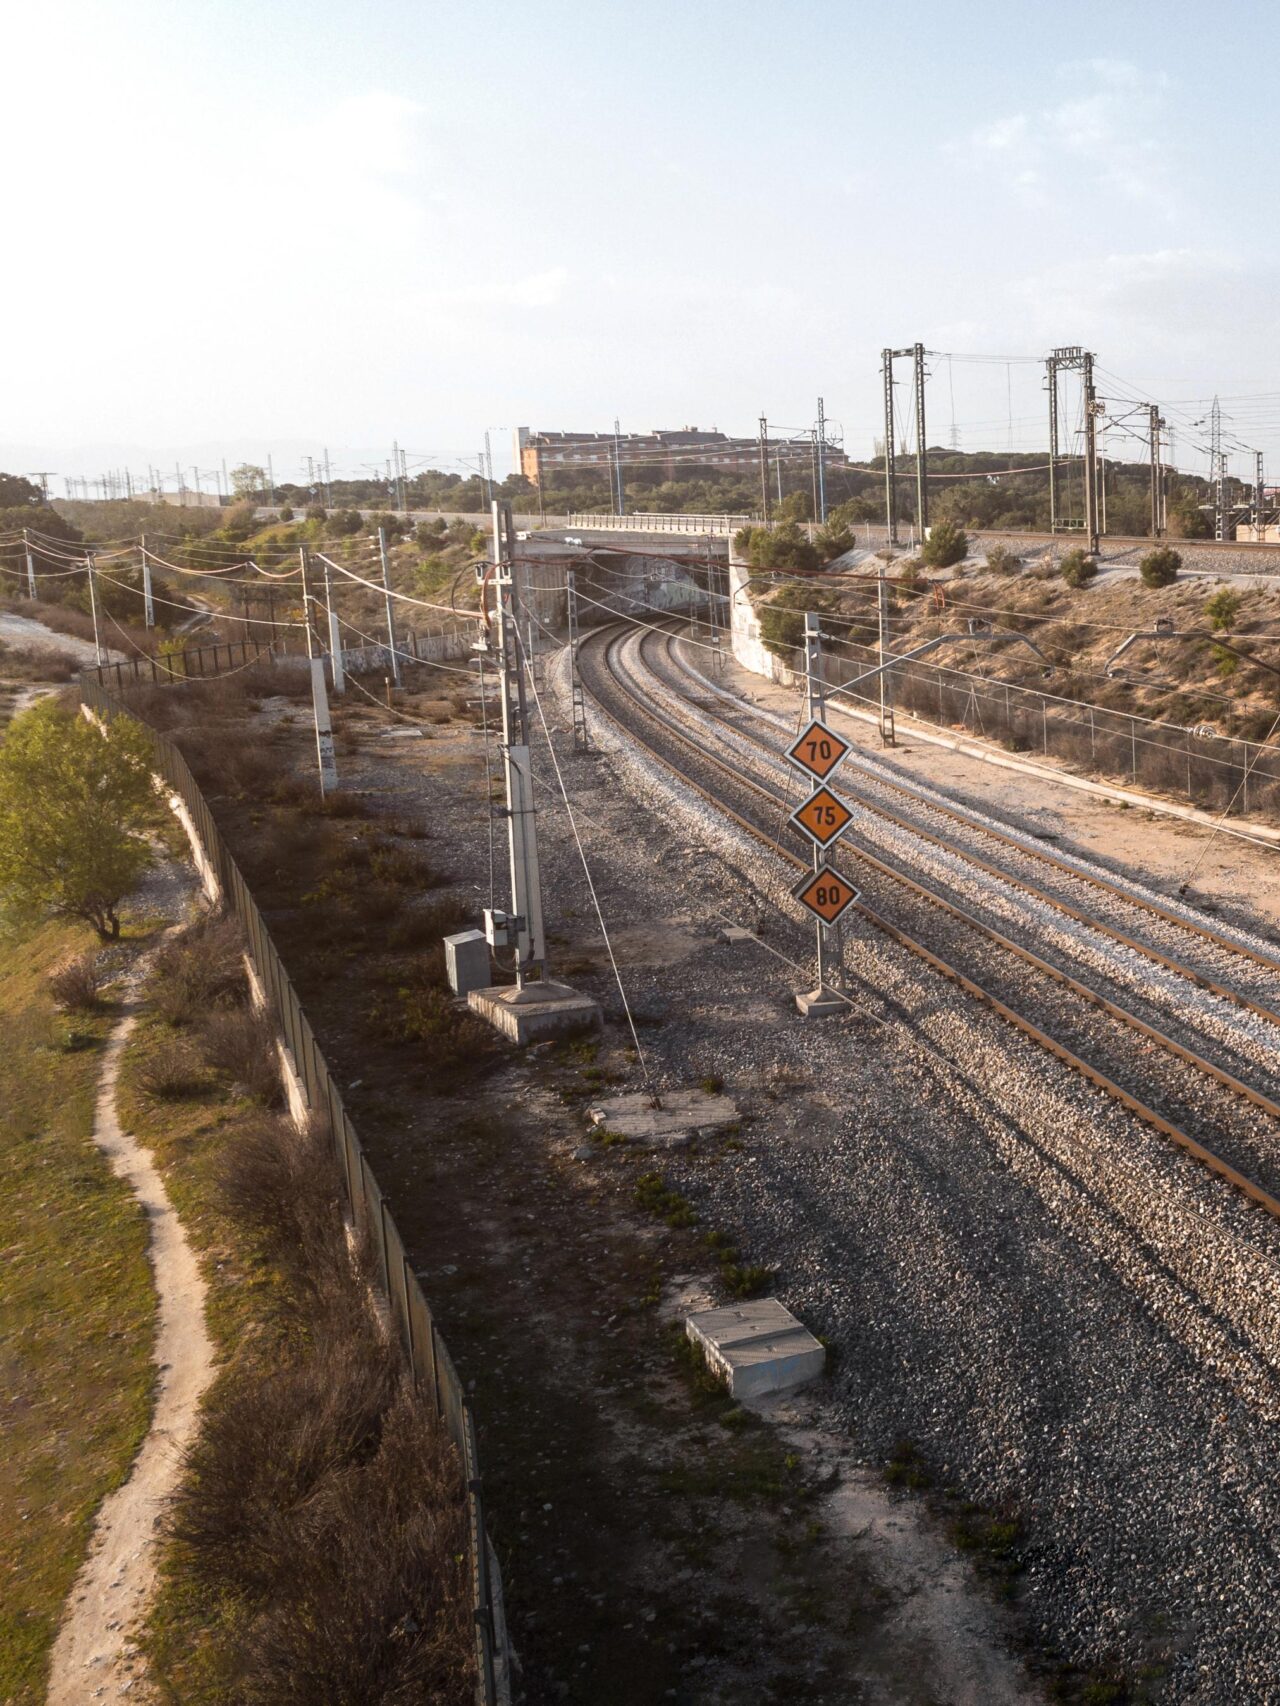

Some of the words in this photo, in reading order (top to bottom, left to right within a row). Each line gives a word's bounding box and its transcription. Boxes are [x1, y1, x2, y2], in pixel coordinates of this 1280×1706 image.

[807, 740, 832, 761] 70
[814, 806, 836, 826] 75
[816, 885, 840, 906] 80
